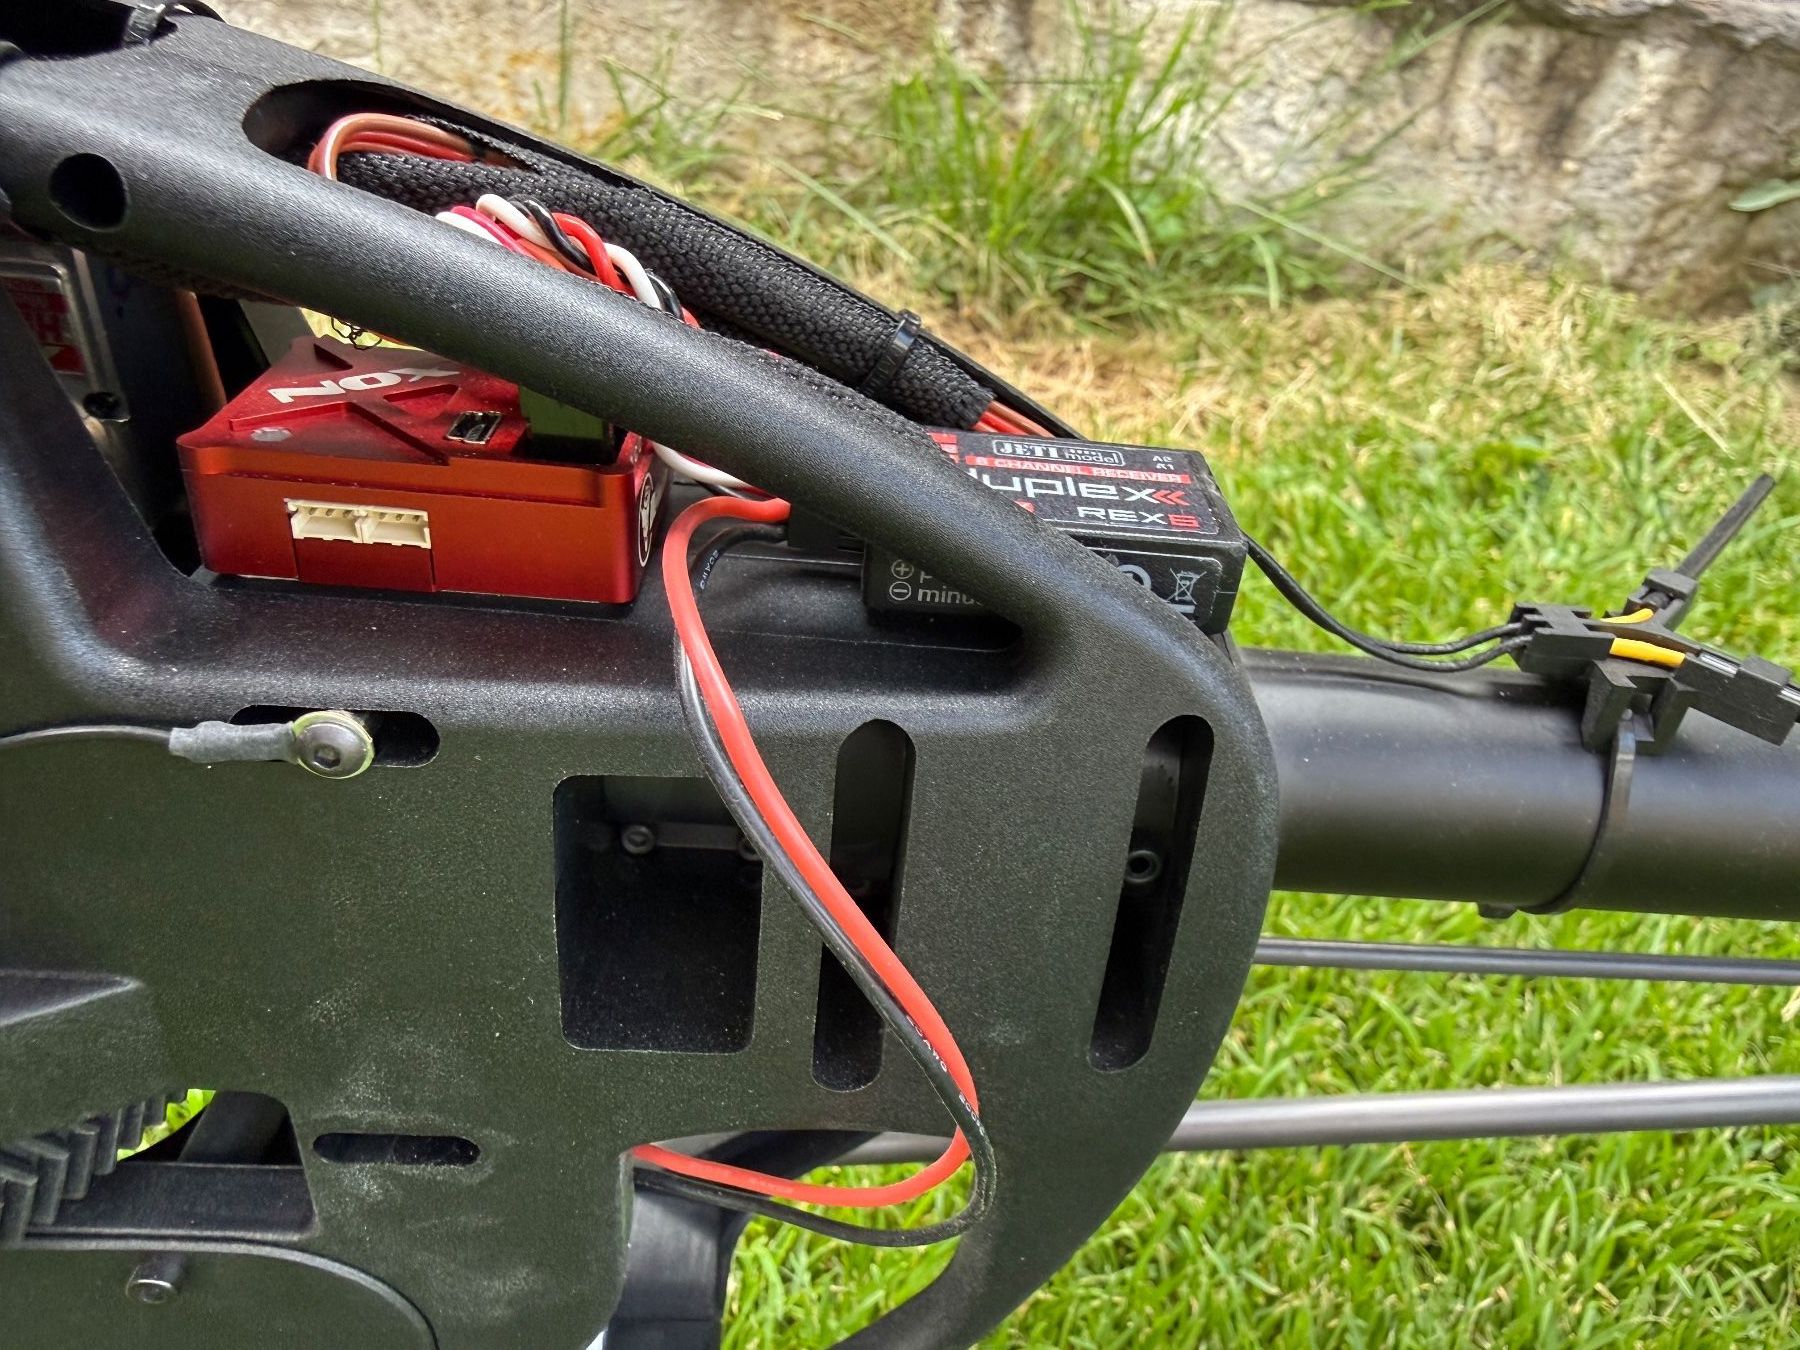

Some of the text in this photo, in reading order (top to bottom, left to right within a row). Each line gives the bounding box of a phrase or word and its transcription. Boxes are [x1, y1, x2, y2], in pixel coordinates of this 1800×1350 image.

[268, 367, 460, 404] NOX
[1000, 442, 1059, 458] JETI
[993, 457, 1082, 475] CHANNEL
[1092, 467, 1182, 484] RECEIVER
[964, 467, 1160, 504] uplex
[917, 585, 982, 606] minu
